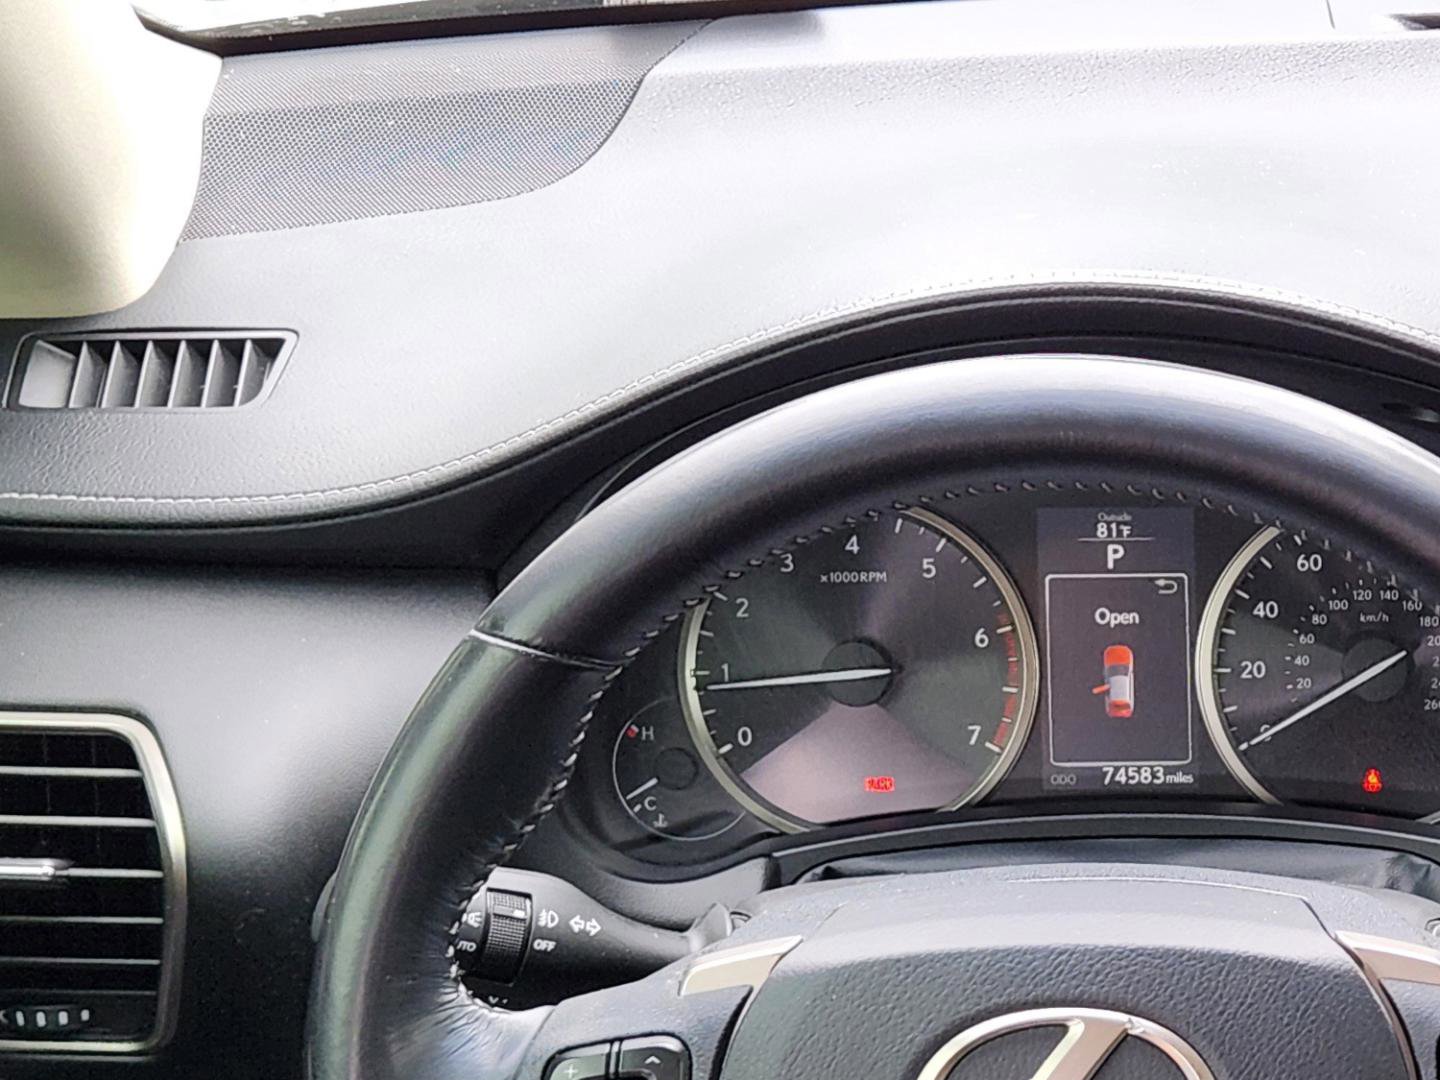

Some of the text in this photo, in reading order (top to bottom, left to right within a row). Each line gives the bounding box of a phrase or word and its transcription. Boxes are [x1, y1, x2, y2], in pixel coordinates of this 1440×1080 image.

[845, 536, 859, 554] 4
[781, 554, 794, 572] 3
[1107, 544, 1125, 569] P
[1297, 555, 1322, 571] 60
[922, 559, 936, 578] 5
[1352, 589, 1372, 601] 120
[1379, 589, 1399, 601] 140
[736, 599, 749, 617] 2
[1253, 601, 1278, 618] 40
[1328, 600, 1349, 611] 100
[1402, 600, 1422, 612] 160
[1095, 608, 1139, 628] Open
[1312, 614, 1328, 625] 80
[1359, 611, 1389, 623] km/h
[1419, 616, 1439, 627] 180
[975, 629, 988, 647] 6
[1299, 633, 1315, 645] 60
[1295, 655, 1310, 666] 40
[721, 664, 729, 682] 1
[1241, 662, 1266, 678] 20
[1296, 678, 1311, 689] 20
[642, 727, 654, 740] H
[738, 727, 752, 745] 0
[968, 726, 981, 745] 7
[1102, 766, 1165, 785] 74583
[644, 797, 656, 810] C
[533, 938, 556, 952] OFF
